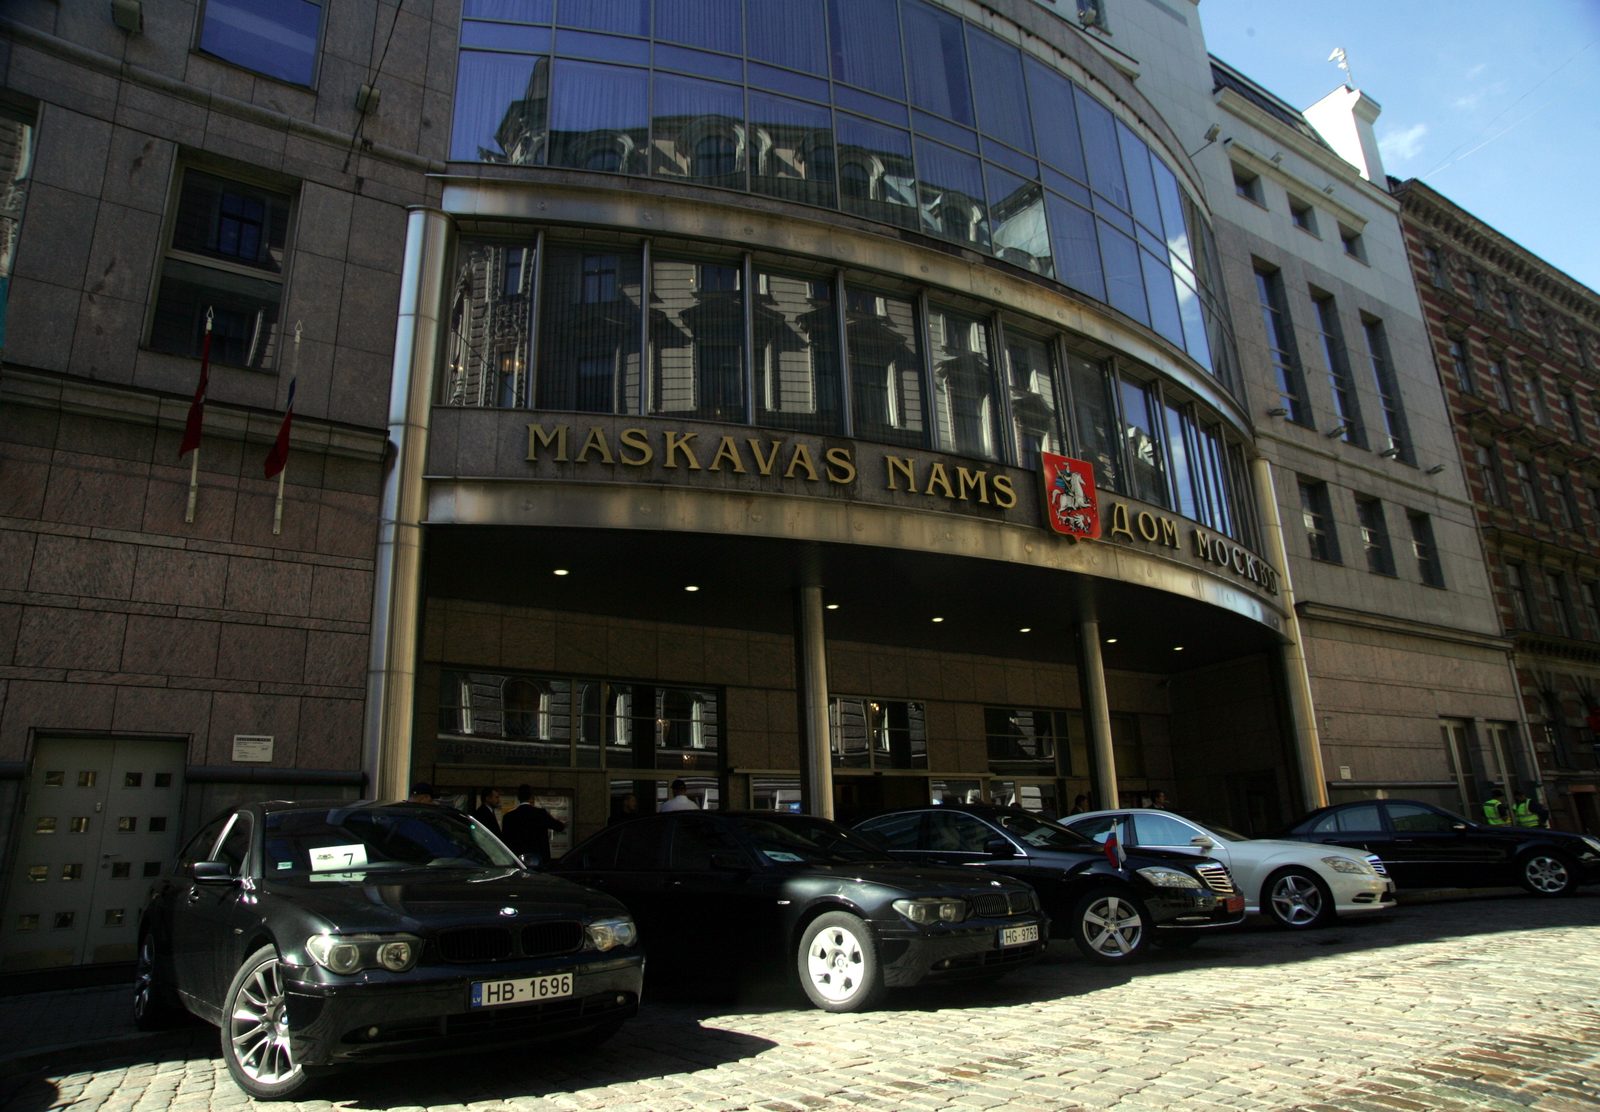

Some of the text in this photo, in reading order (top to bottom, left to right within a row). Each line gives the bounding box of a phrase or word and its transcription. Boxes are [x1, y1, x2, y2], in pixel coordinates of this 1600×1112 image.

[525, 423, 1018, 510] MASKAVAS NAMS
[1111, 502, 1278, 596] ДОМ МОСКВЫ
[343, 852, 354, 866] 7
[1005, 926, 1037, 944] HG-9759
[487, 976, 570, 1003] HB-1696
